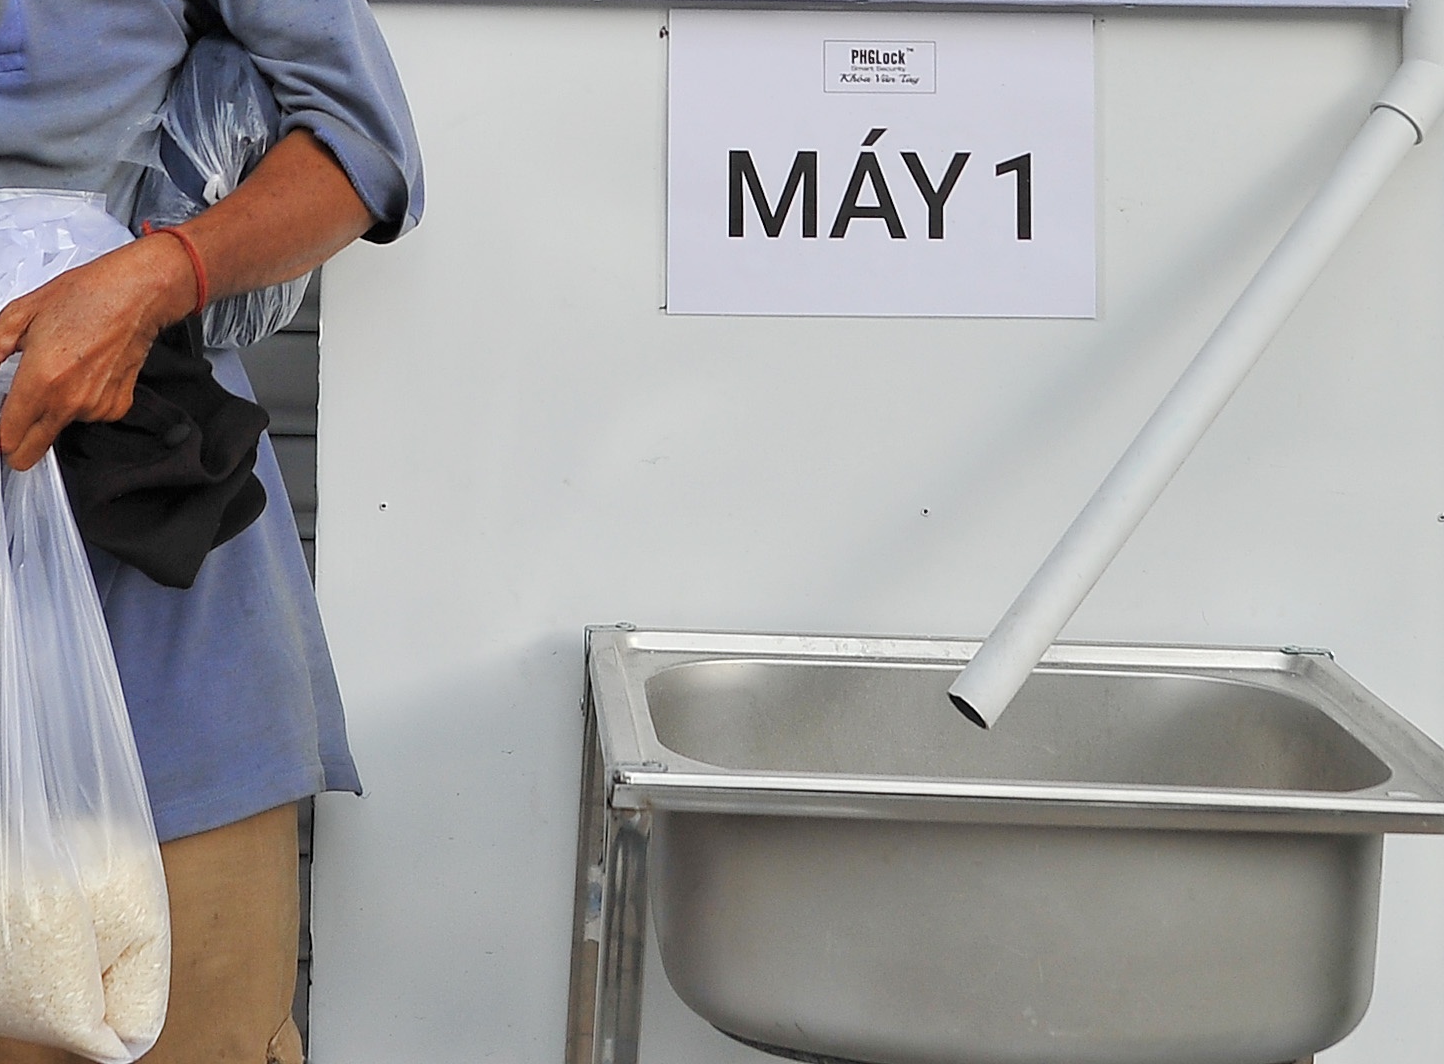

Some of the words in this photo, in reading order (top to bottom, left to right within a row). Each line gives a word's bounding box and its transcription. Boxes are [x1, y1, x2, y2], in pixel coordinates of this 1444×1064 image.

[899, 73, 920, 85] Tay
[728, 127, 972, 241] MÁY
[995, 152, 1032, 241] 1
